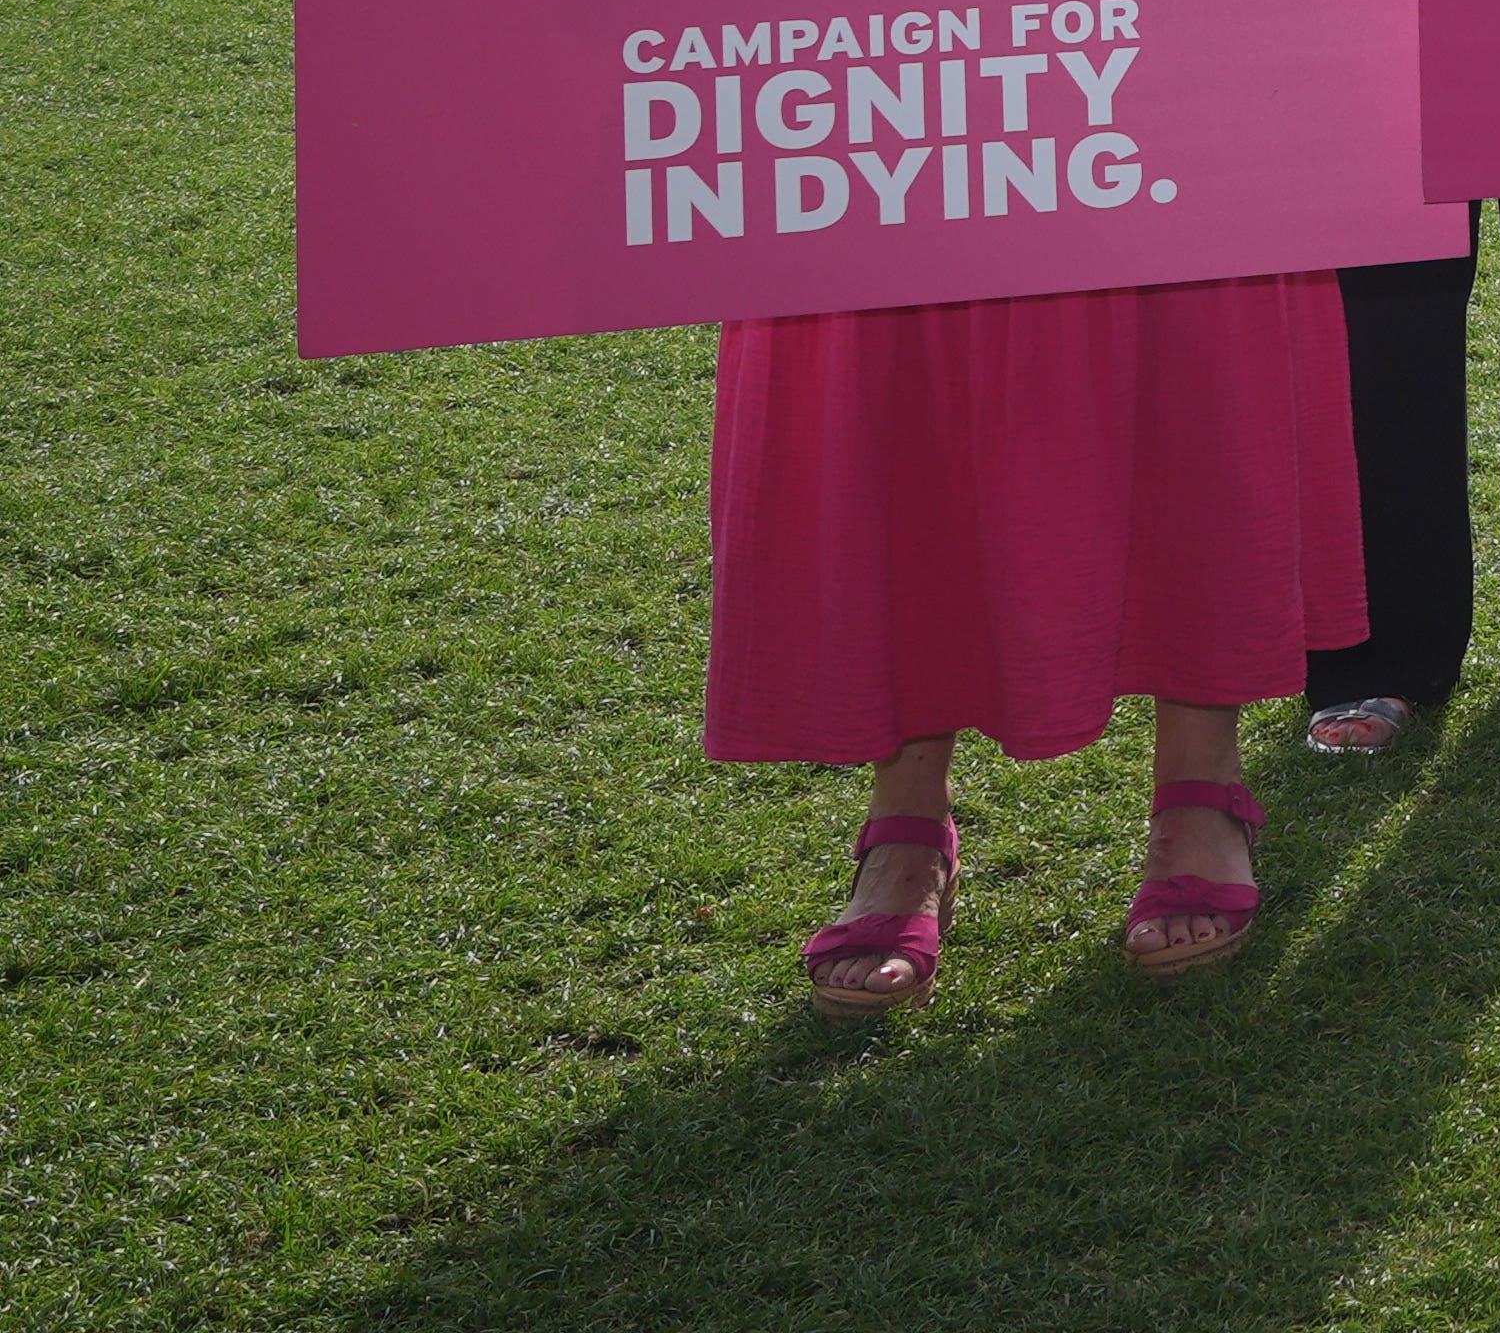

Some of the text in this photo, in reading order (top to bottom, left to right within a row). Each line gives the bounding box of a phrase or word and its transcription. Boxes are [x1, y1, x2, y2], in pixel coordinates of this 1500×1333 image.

[623, 8, 980, 73] CAMPAIGN
[622, 46, 1139, 162] DIGNITY
[625, 132, 1177, 245] IN DYING.
